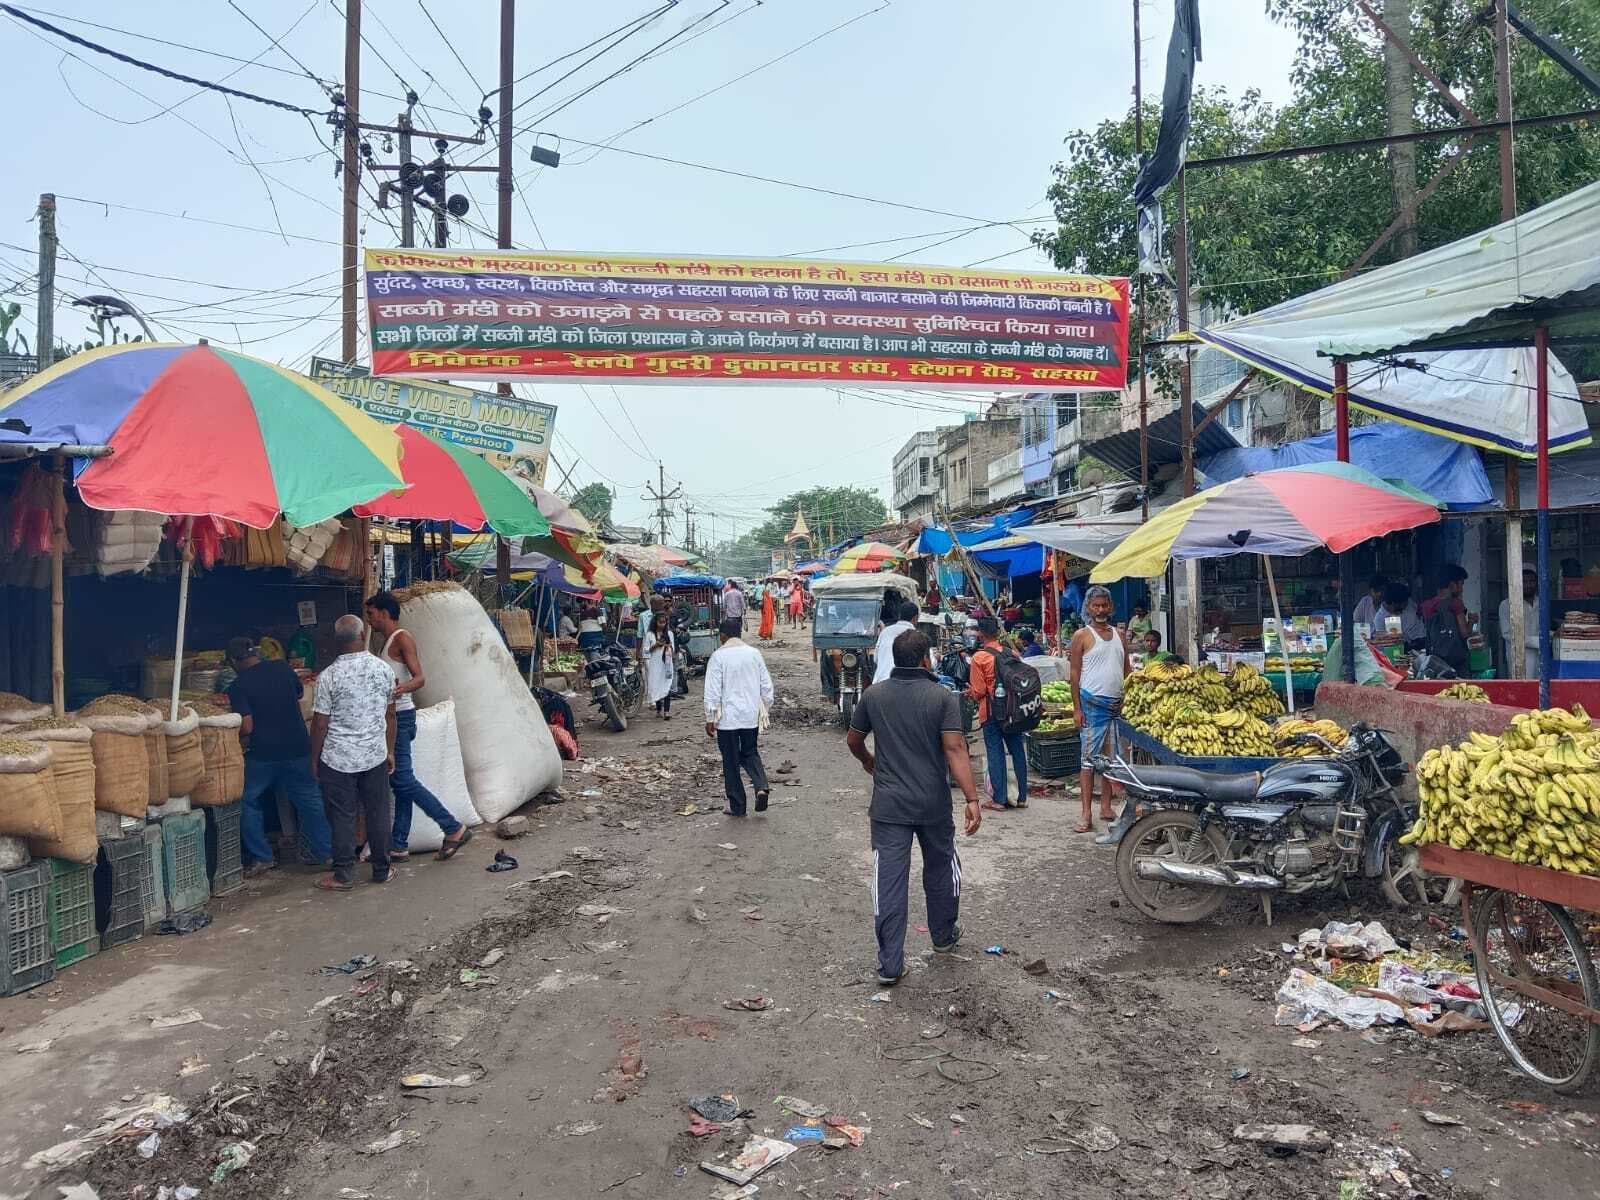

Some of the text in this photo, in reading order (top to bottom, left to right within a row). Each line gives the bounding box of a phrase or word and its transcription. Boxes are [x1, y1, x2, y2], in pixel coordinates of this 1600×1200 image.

[584, 261, 611, 273] की
[619, 262, 669, 274] सब्जी
[718, 264, 744, 277] को
[806, 265, 820, 280] है
[860, 271, 888, 283] इस
[894, 270, 925, 284] मंडी
[930, 273, 953, 286] को
[959, 277, 1009, 289] बसाना
[1014, 277, 1033, 290] भी
[373, 272, 416, 294] सुंदर,
[421, 277, 470, 291] स्वच्छ,
[475, 279, 525, 292] स्वस्थ,
[530, 277, 594, 292] विकसित
[600, 279, 627, 294] और
[678, 284, 727, 297] सहरसा
[731, 284, 769, 298] बनाने
[772, 285, 788, 299] के
[792, 285, 818, 301] लिए
[822, 288, 857, 302] सब्जी
[861, 291, 898, 304] बाजार
[901, 289, 938, 305] बसाने
[941, 293, 958, 306] की
[1018, 295, 1061, 312] किसकी
[1062, 299, 1092, 314] बनती
[1094, 300, 1103, 315] है
[1106, 302, 1111, 315] ?
[379, 300, 1094, 338] सब्जी मंडी को उजाड़ने से पहले बसाने की व्यवस्था सुनिश्चित किया जाए।
[376, 325, 411, 343] सभी
[416, 325, 460, 343] जिलों
[462, 325, 480, 342] में
[481, 325, 524, 343] सब्जी
[528, 326, 559, 343] मंडी
[561, 327, 586, 343] को
[589, 327, 626, 344] जिला
[631, 331, 687, 346] प्रशासन
[690, 330, 704, 346] ने
[708, 331, 744, 347] अपने
[748, 331, 798, 348] नियंत्रण
[802, 332, 816, 348] में
[818, 338, 859, 350] बसाया
[882, 340, 908, 352] आप
[911, 338, 927, 352] भी
[931, 341, 970, 355] सहरसा
[974, 340, 987, 355] के
[990, 340, 1021, 357] सब्जी
[1023, 341, 1044, 358] मंडी
[1047, 344, 1063, 358] को
[1065, 347, 1093, 360] जगह
[408, 351, 521, 368] निवेदक
[563, 352, 636, 369] रेलवे
[722, 357, 842, 375] दुकानदार
[907, 361, 975, 378] स्टेशन
[981, 362, 1024, 381] रोड,
[1031, 366, 1099, 382] सहरसा
[408, 387, 471, 419] VIDEO
[479, 401, 546, 434] MOVIE
[451, 430, 508, 449] Preshoot
